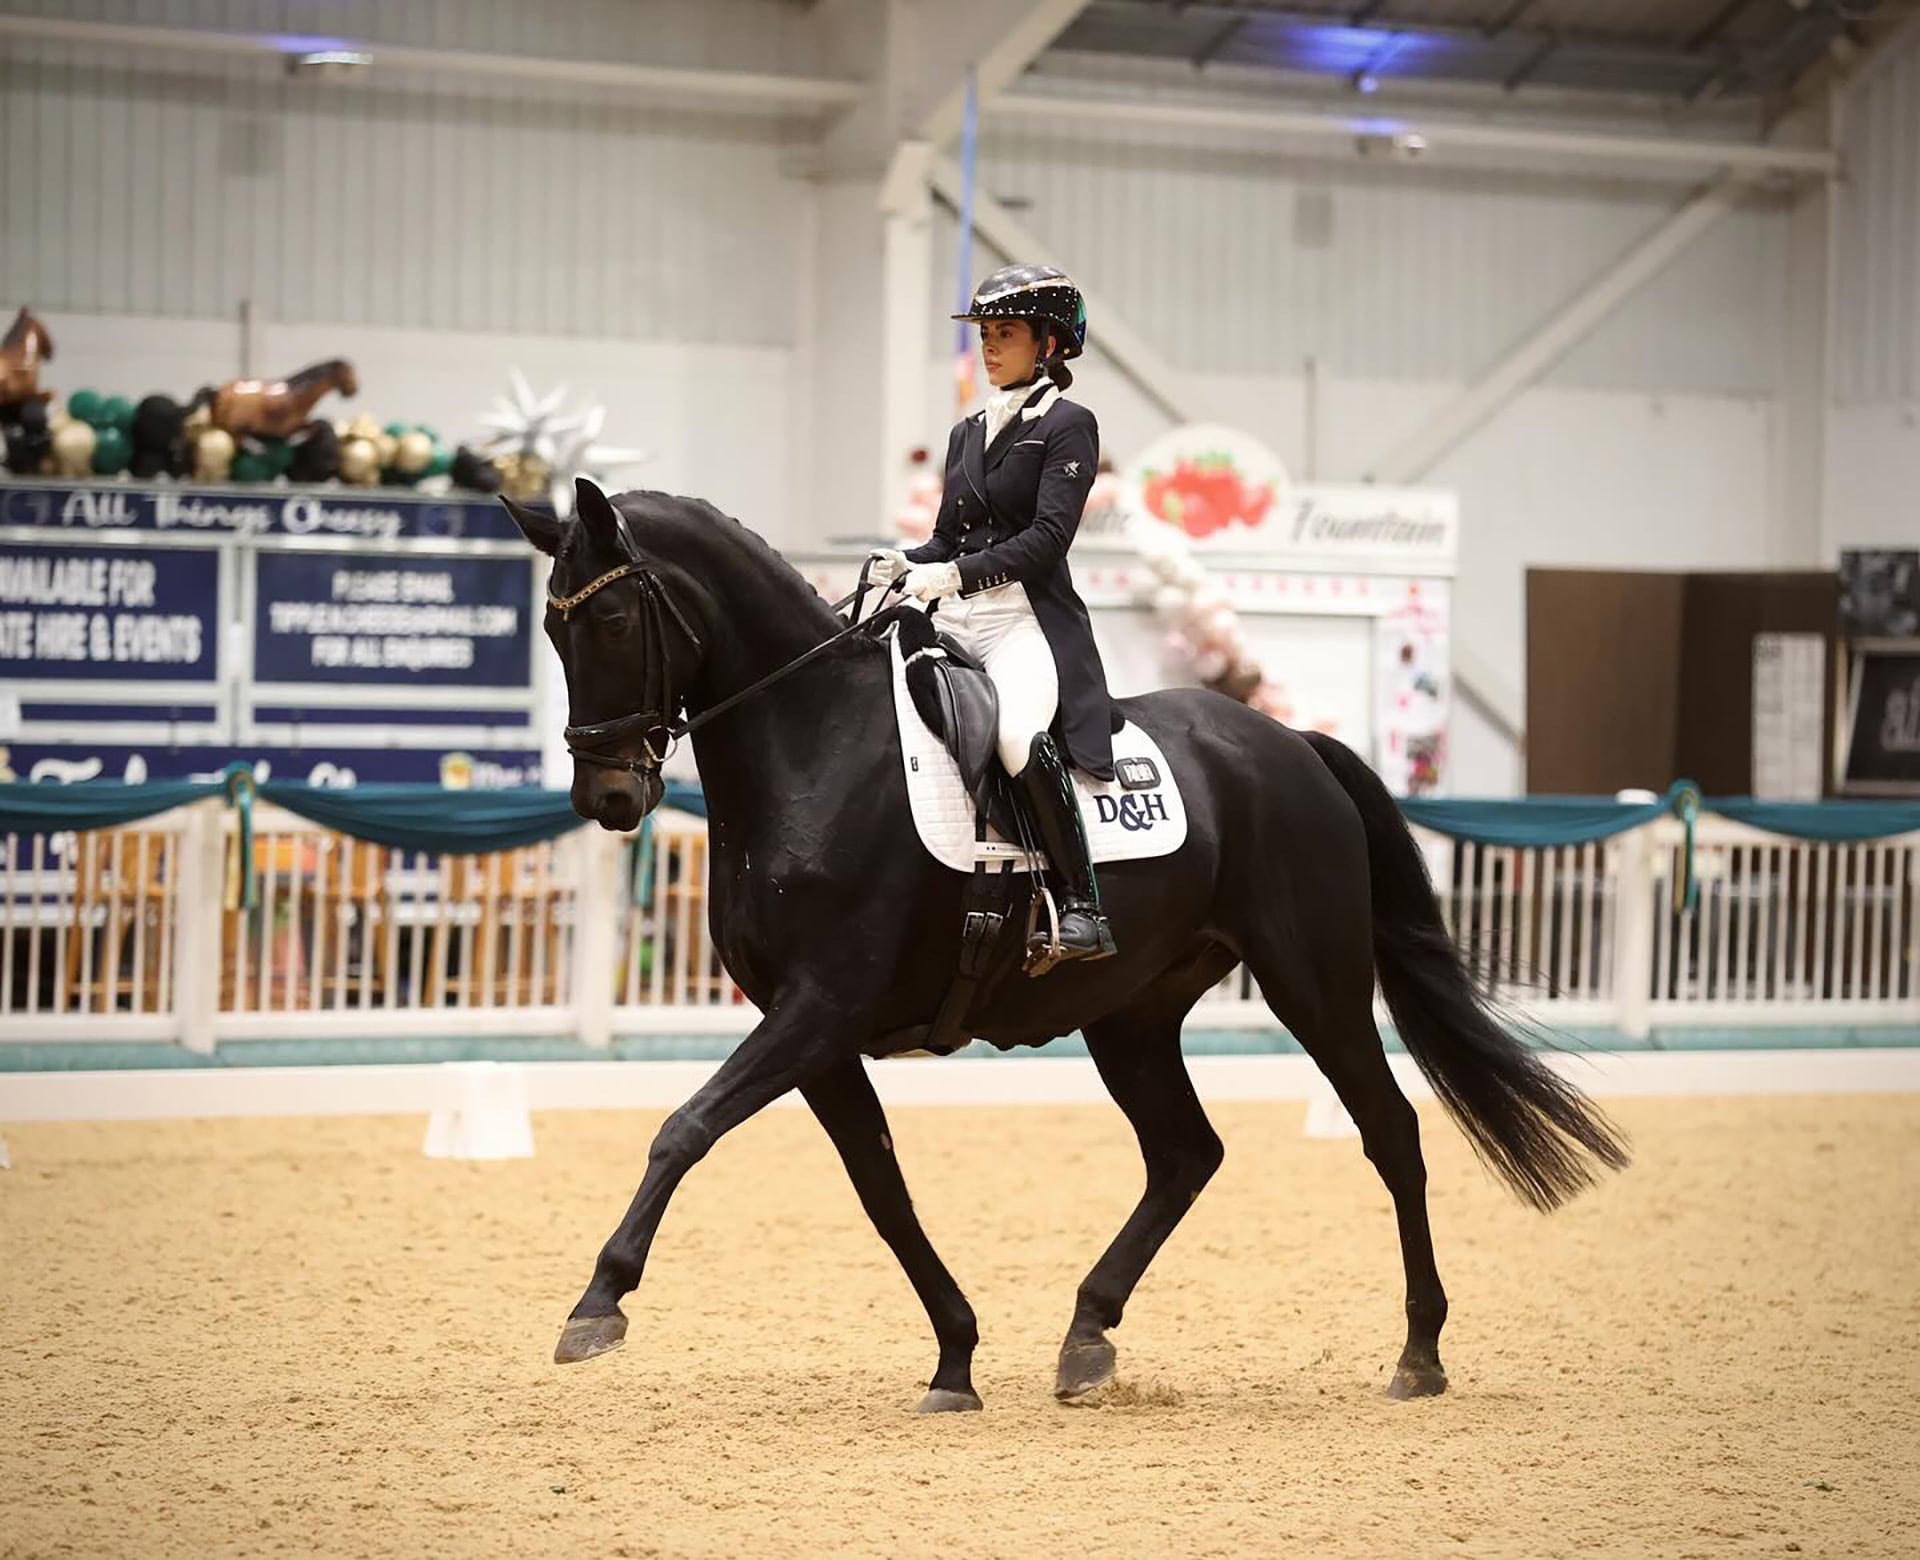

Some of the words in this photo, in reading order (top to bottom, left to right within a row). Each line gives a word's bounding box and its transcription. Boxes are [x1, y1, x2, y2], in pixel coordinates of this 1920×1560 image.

[61, 487, 139, 527] All
[143, 489, 273, 540] Things
[109, 558, 156, 607] FOR
[332, 571, 398, 602] PLEASE
[35, 612, 88, 660] HIRE
[89, 613, 111, 662] &
[113, 614, 202, 664] EVENTS
[311, 636, 349, 667] FOR
[351, 636, 381, 667] ALL
[1092, 794, 1170, 831] D&H
